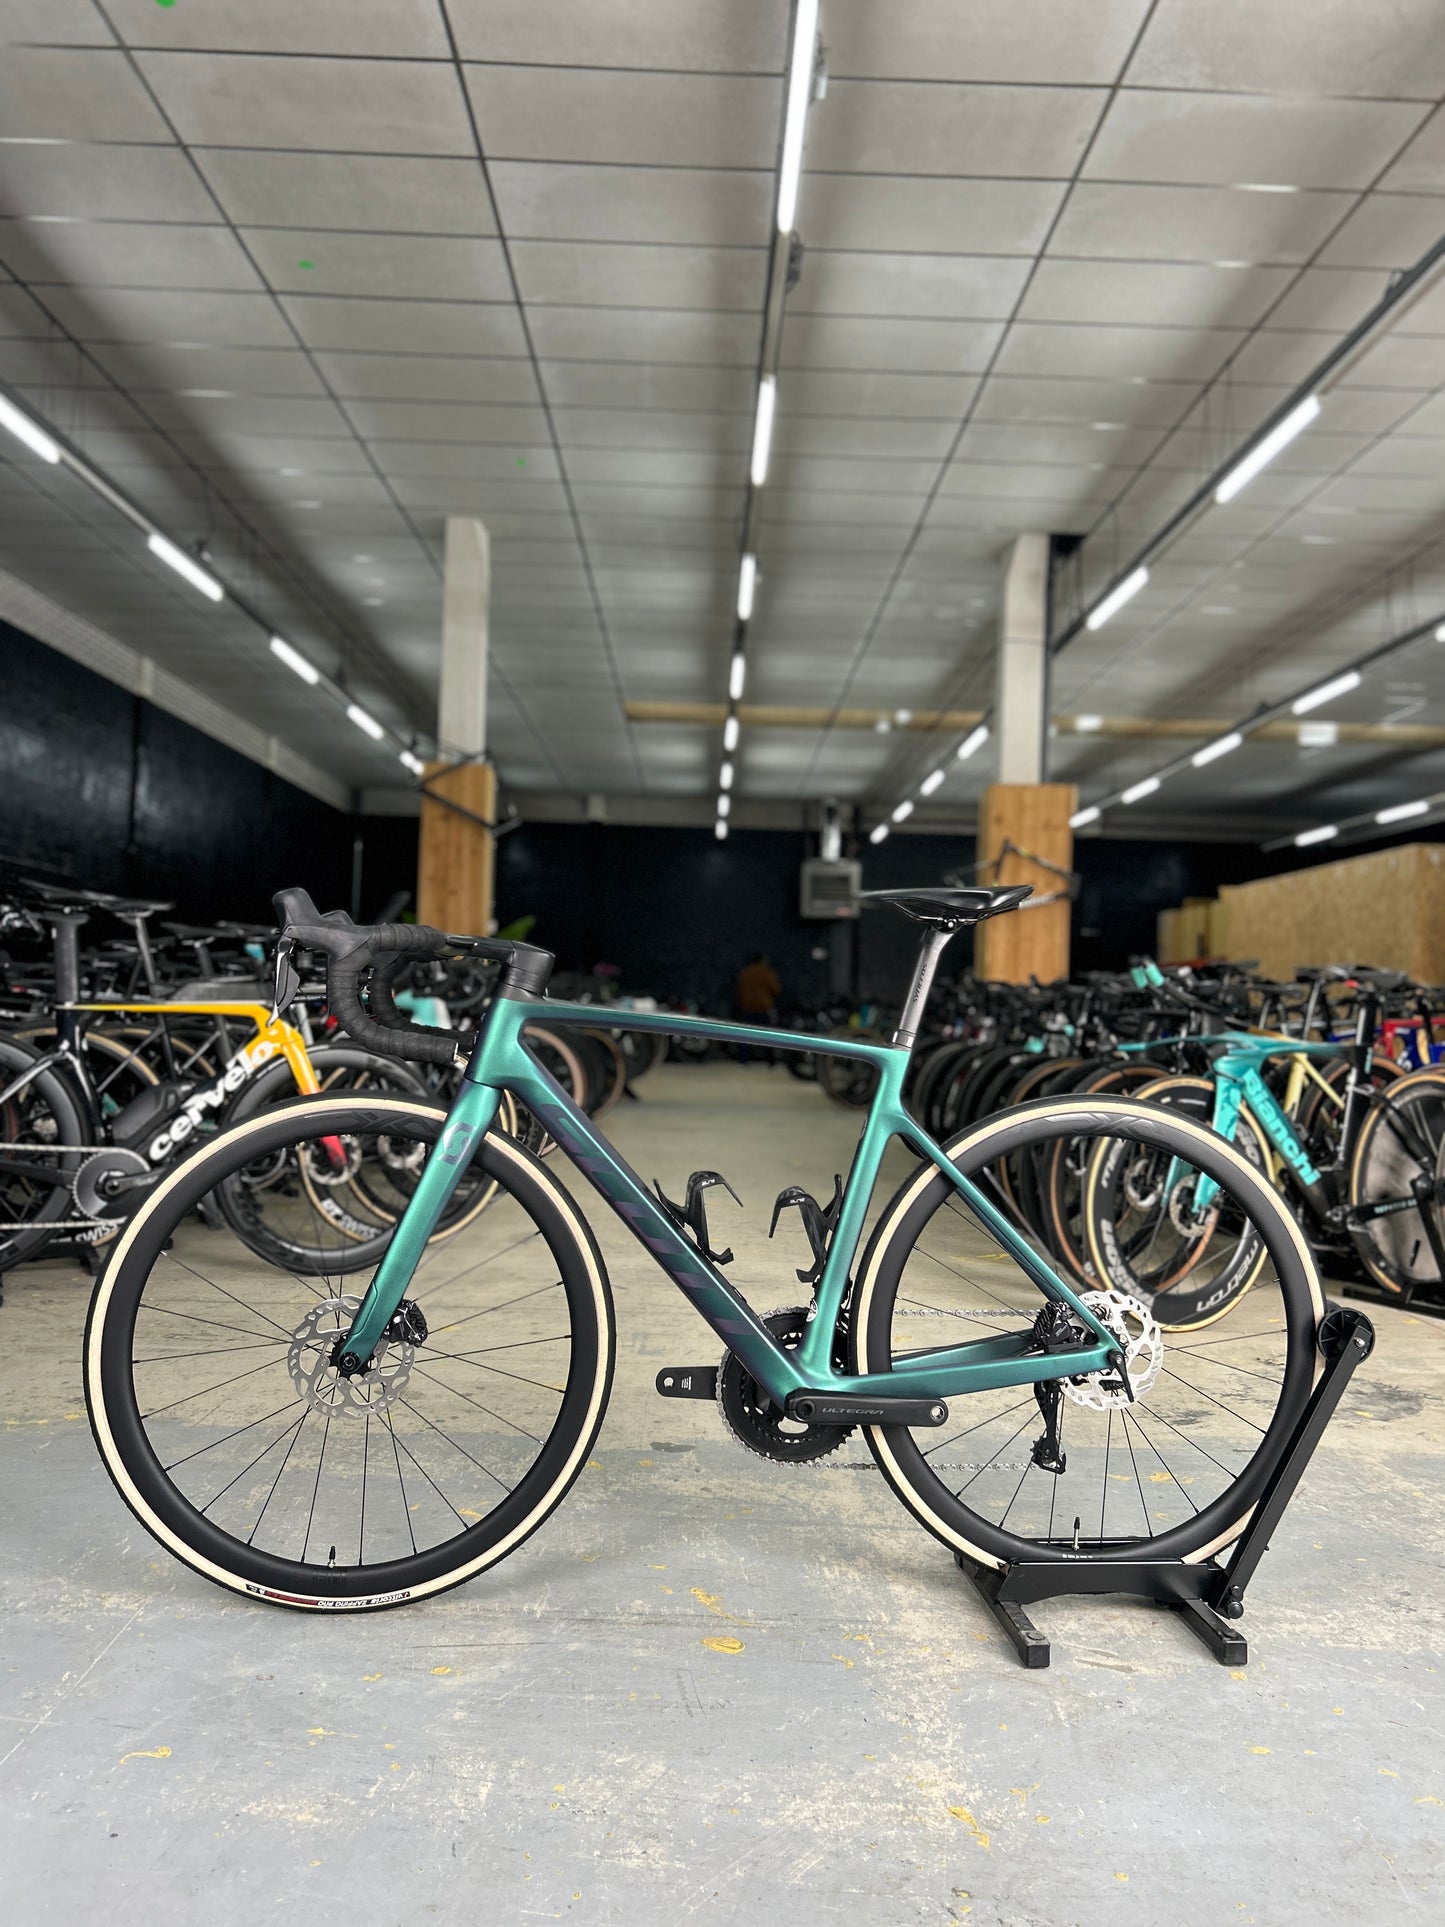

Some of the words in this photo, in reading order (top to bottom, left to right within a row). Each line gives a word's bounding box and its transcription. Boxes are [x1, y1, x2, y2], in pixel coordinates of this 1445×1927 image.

[1243, 1069, 1322, 1186] Bianchi
[1196, 1240, 1258, 1312] metron
[822, 1407, 884, 1415] ULTEGRA
